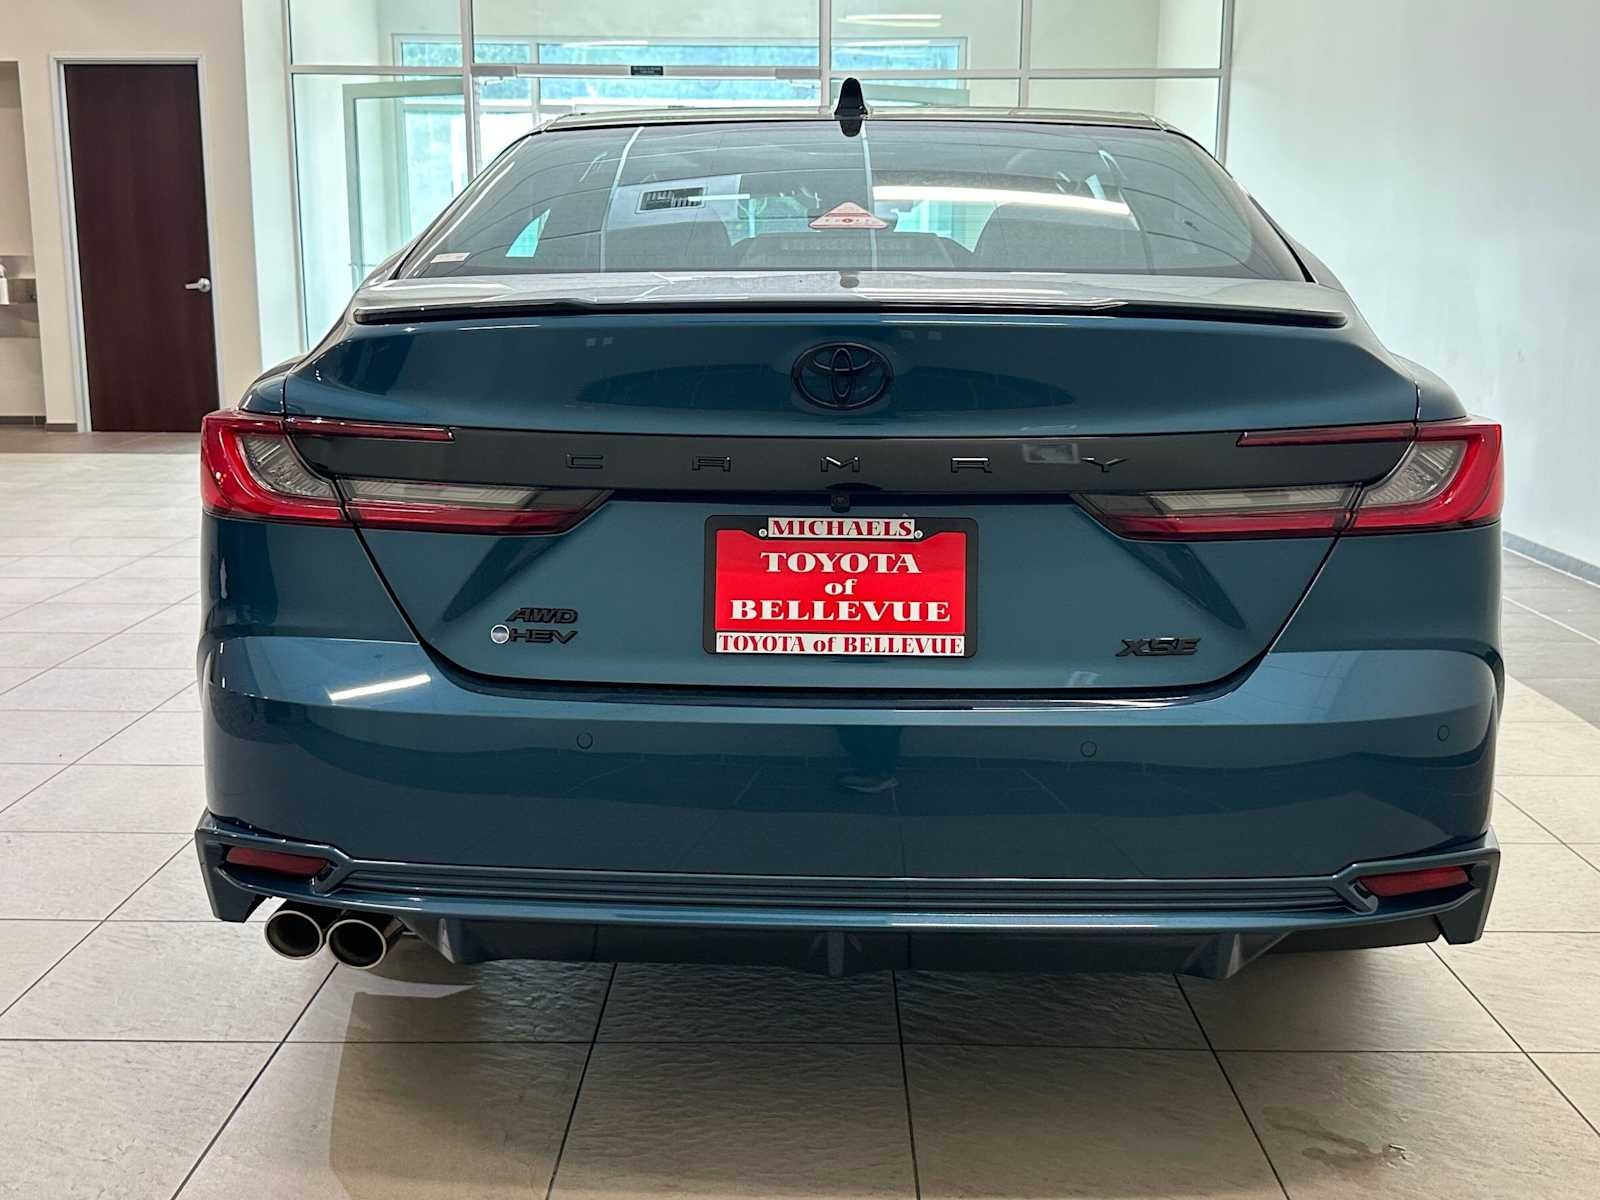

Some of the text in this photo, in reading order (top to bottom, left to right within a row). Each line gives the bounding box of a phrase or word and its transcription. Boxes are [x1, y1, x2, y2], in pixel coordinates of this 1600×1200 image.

[566, 453, 1128, 473] CAMRY
[771, 519, 913, 537] MICHAELS
[760, 552, 922, 574] TOYOTA
[824, 579, 857, 596] of
[506, 608, 578, 624] AWD
[730, 600, 951, 622] BELLEVUE
[510, 628, 578, 644] HEV
[718, 635, 964, 655] TOYOTA of BELLEVUE
[1114, 638, 1201, 656] XSE
